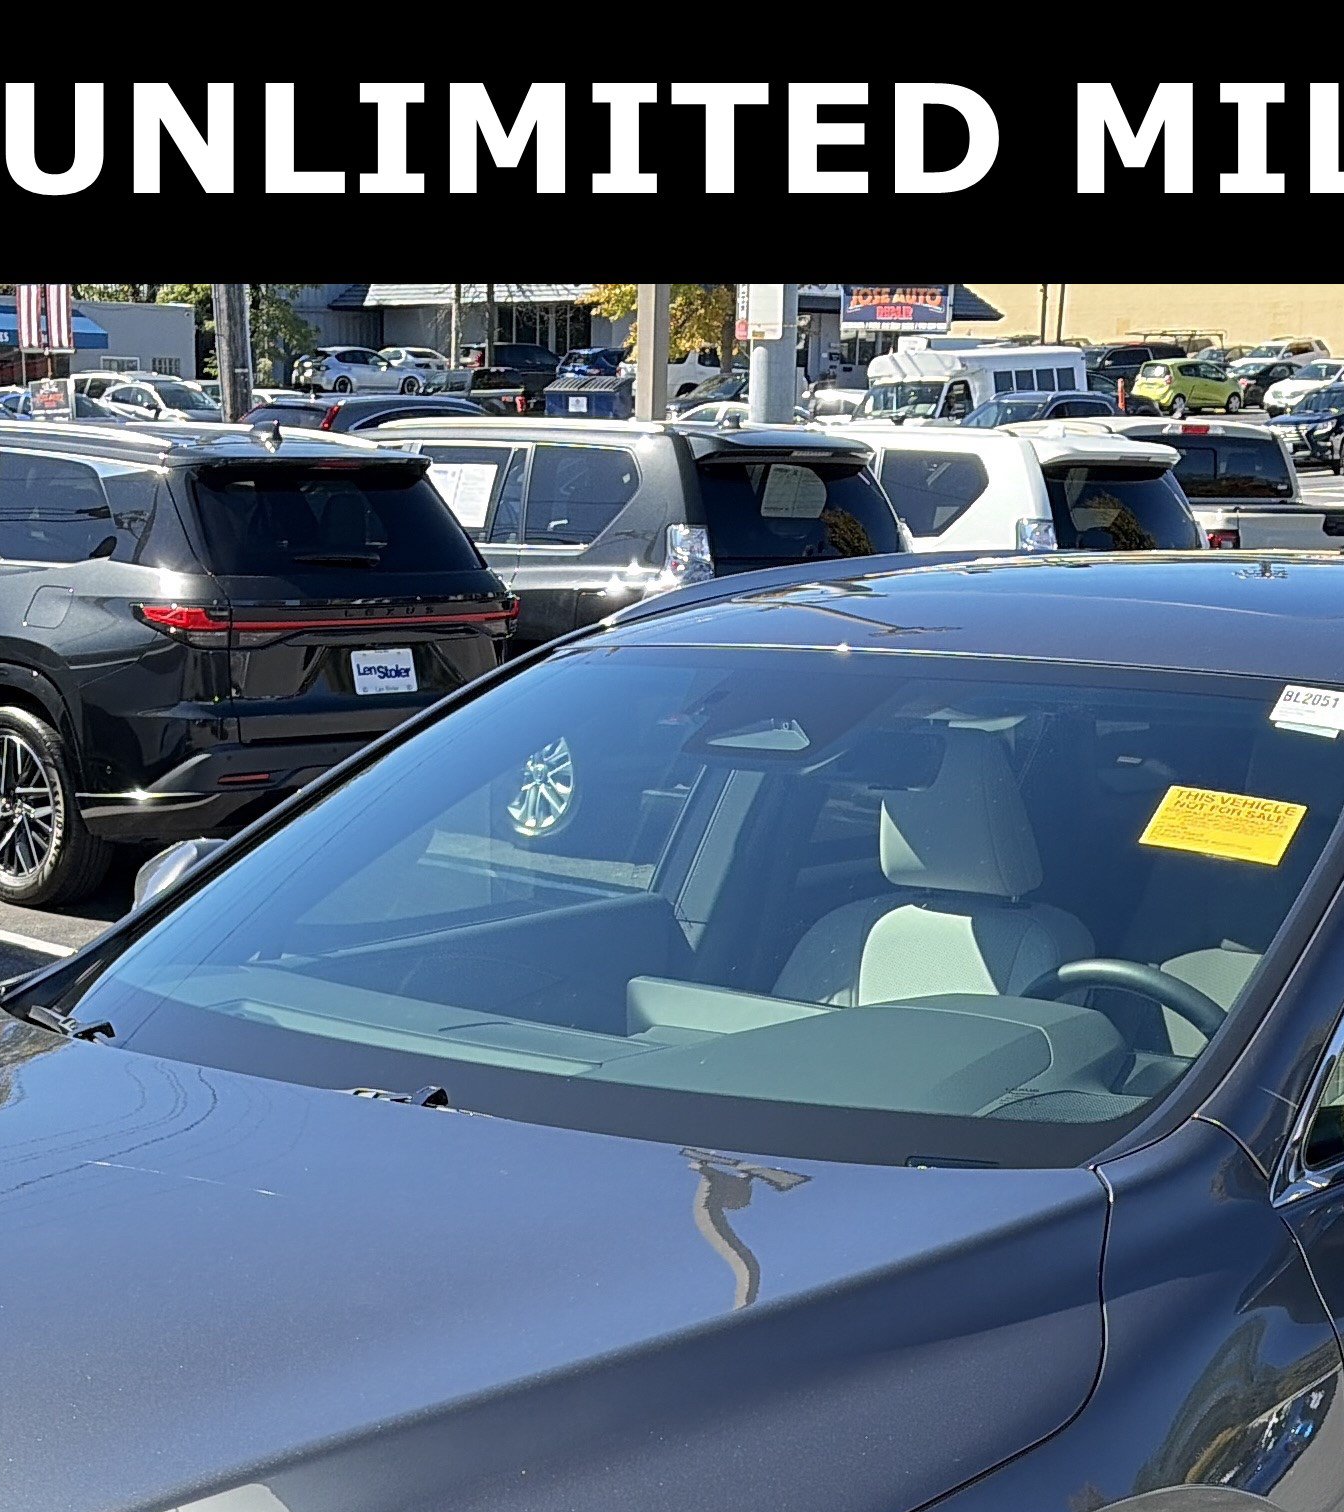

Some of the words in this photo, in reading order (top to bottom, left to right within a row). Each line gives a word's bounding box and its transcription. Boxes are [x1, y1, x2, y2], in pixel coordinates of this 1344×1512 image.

[892, 287, 943, 307] AUTO
[1175, 789, 1216, 805] THIS
[1220, 795, 1297, 817] VEHICLE
